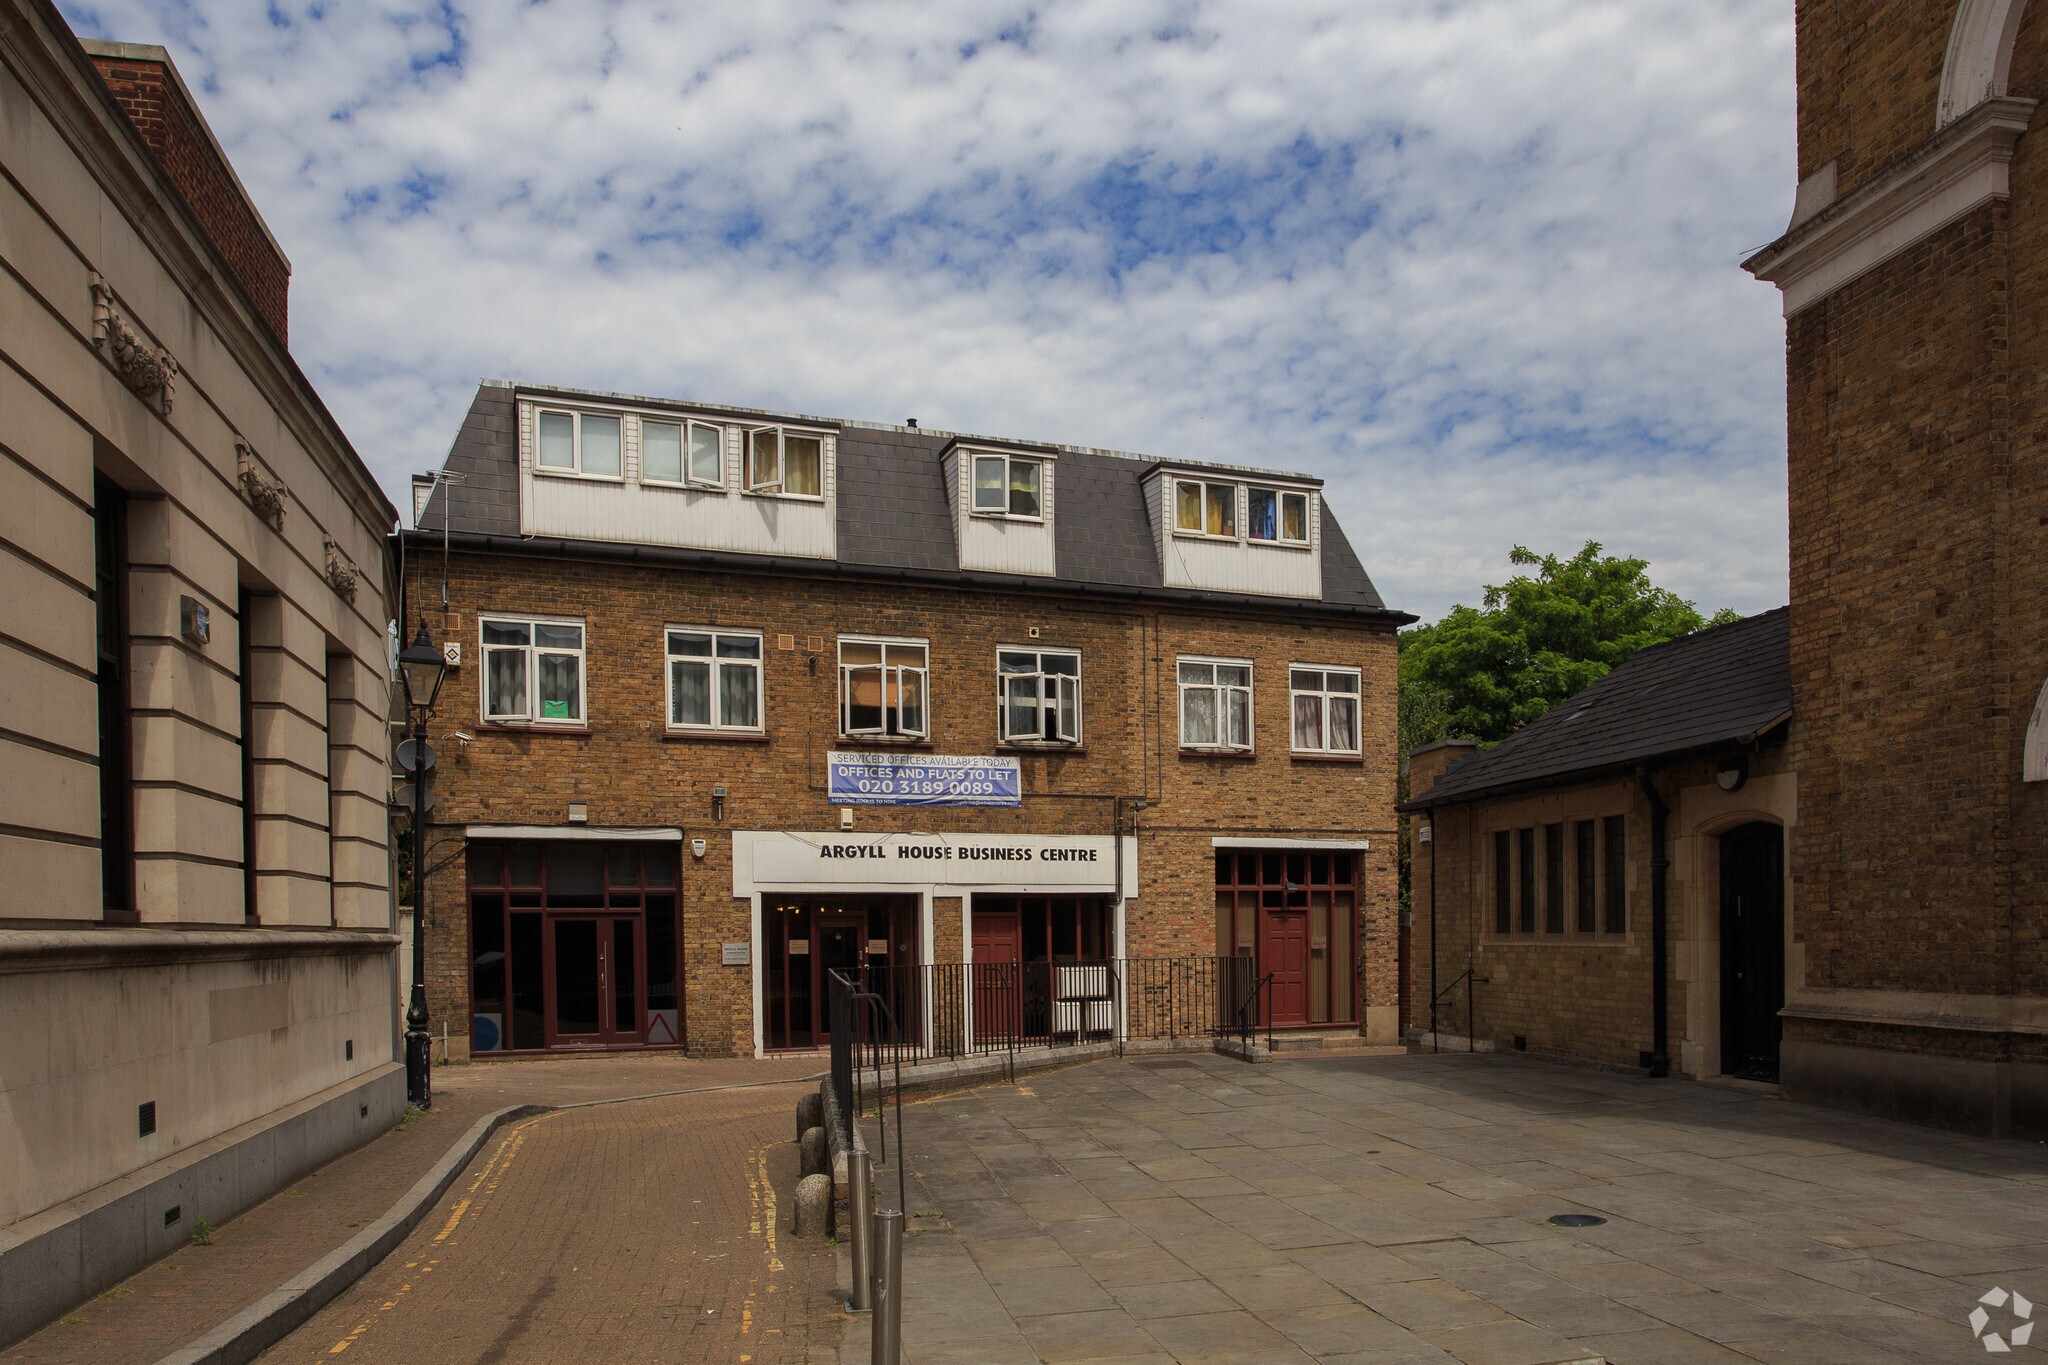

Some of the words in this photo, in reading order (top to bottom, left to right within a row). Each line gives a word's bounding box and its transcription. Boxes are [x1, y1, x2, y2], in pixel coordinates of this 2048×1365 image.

[838, 754, 884, 764] SERVICED
[888, 755, 926, 765] OFFICES
[930, 757, 978, 766] AVAILABLE
[982, 758, 1010, 767] TODAY
[838, 767, 892, 778] OFFICES
[896, 768, 924, 778] AND
[928, 769, 964, 779] FLATS
[968, 770, 984, 780] TO
[989, 771, 1011, 780] LET
[858, 780, 893, 793] 020
[900, 781, 943, 794] 3189
[950, 782, 993, 794] 0089
[820, 845, 886, 858] ARGYLL
[898, 846, 952, 859] HOUSE
[958, 847, 1032, 860] BUSINESS
[1040, 849, 1096, 861] CENTRE
